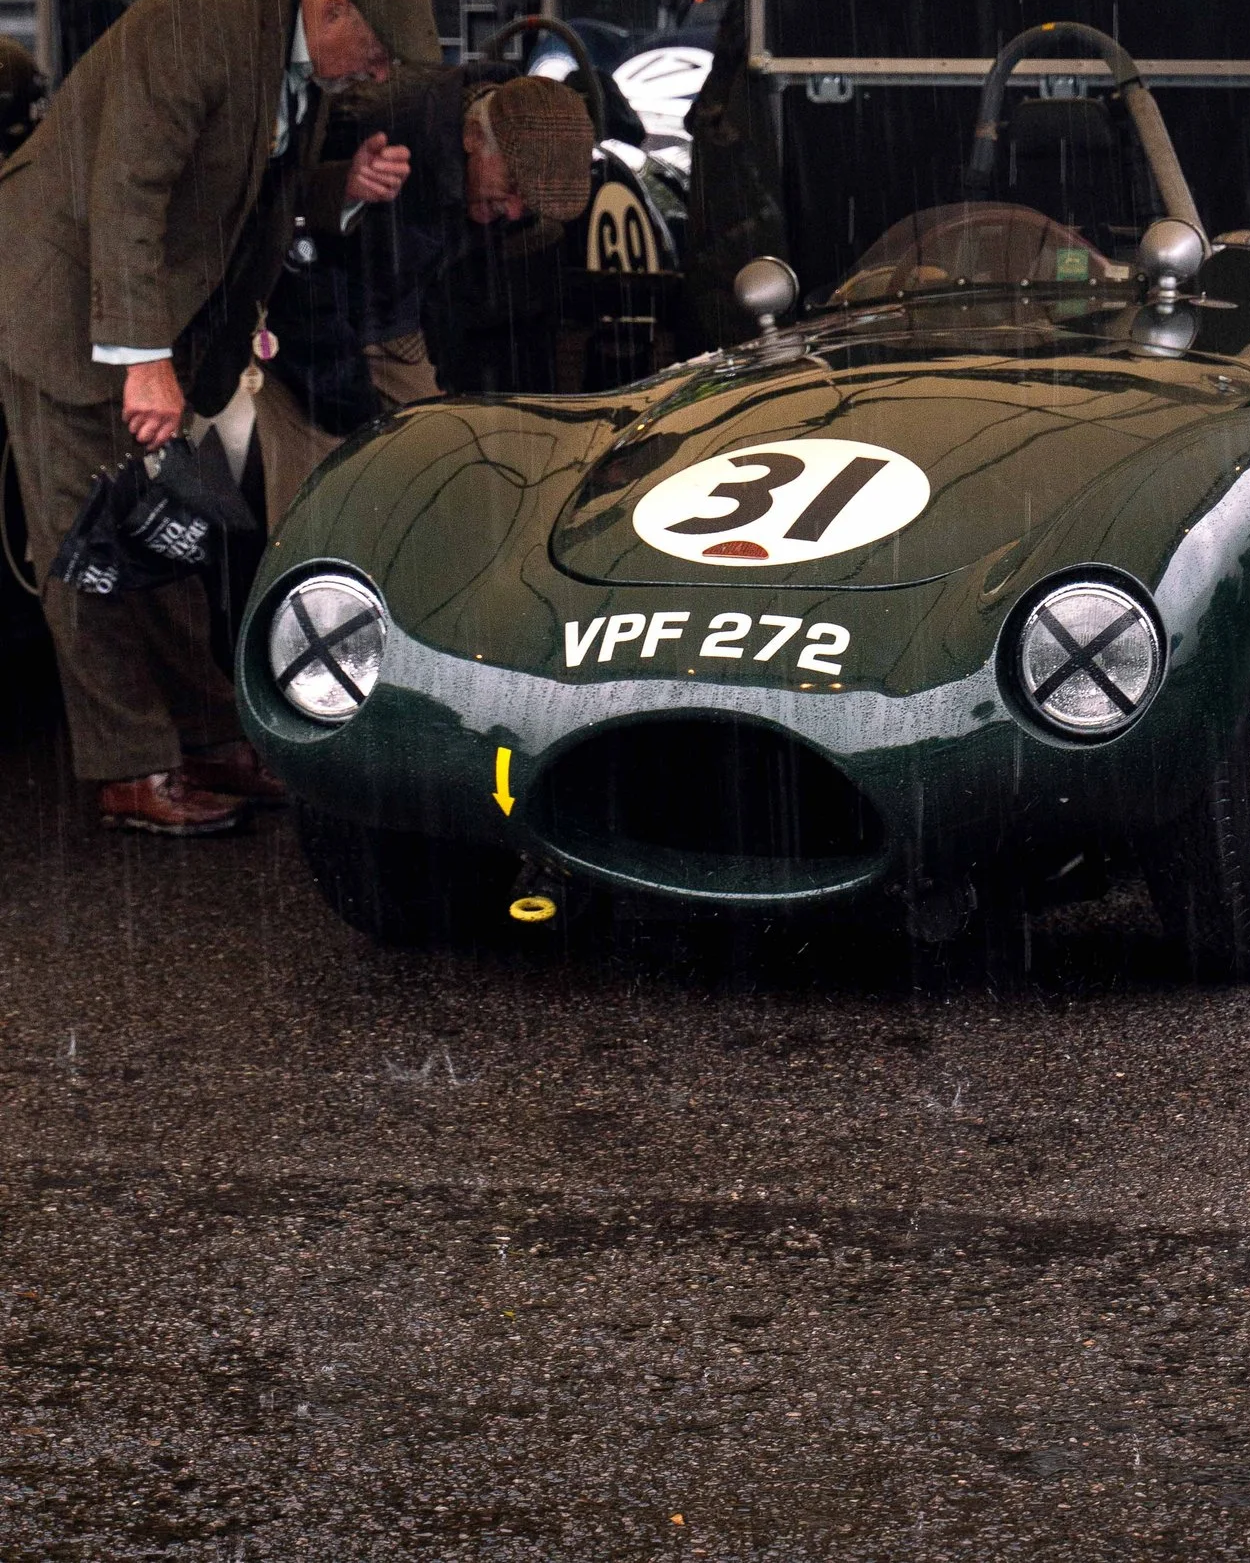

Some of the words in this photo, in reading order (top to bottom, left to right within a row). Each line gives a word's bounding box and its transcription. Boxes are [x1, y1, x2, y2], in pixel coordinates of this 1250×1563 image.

[664, 452, 890, 542] 31
[563, 611, 690, 668] VPF
[700, 611, 851, 676] 272
